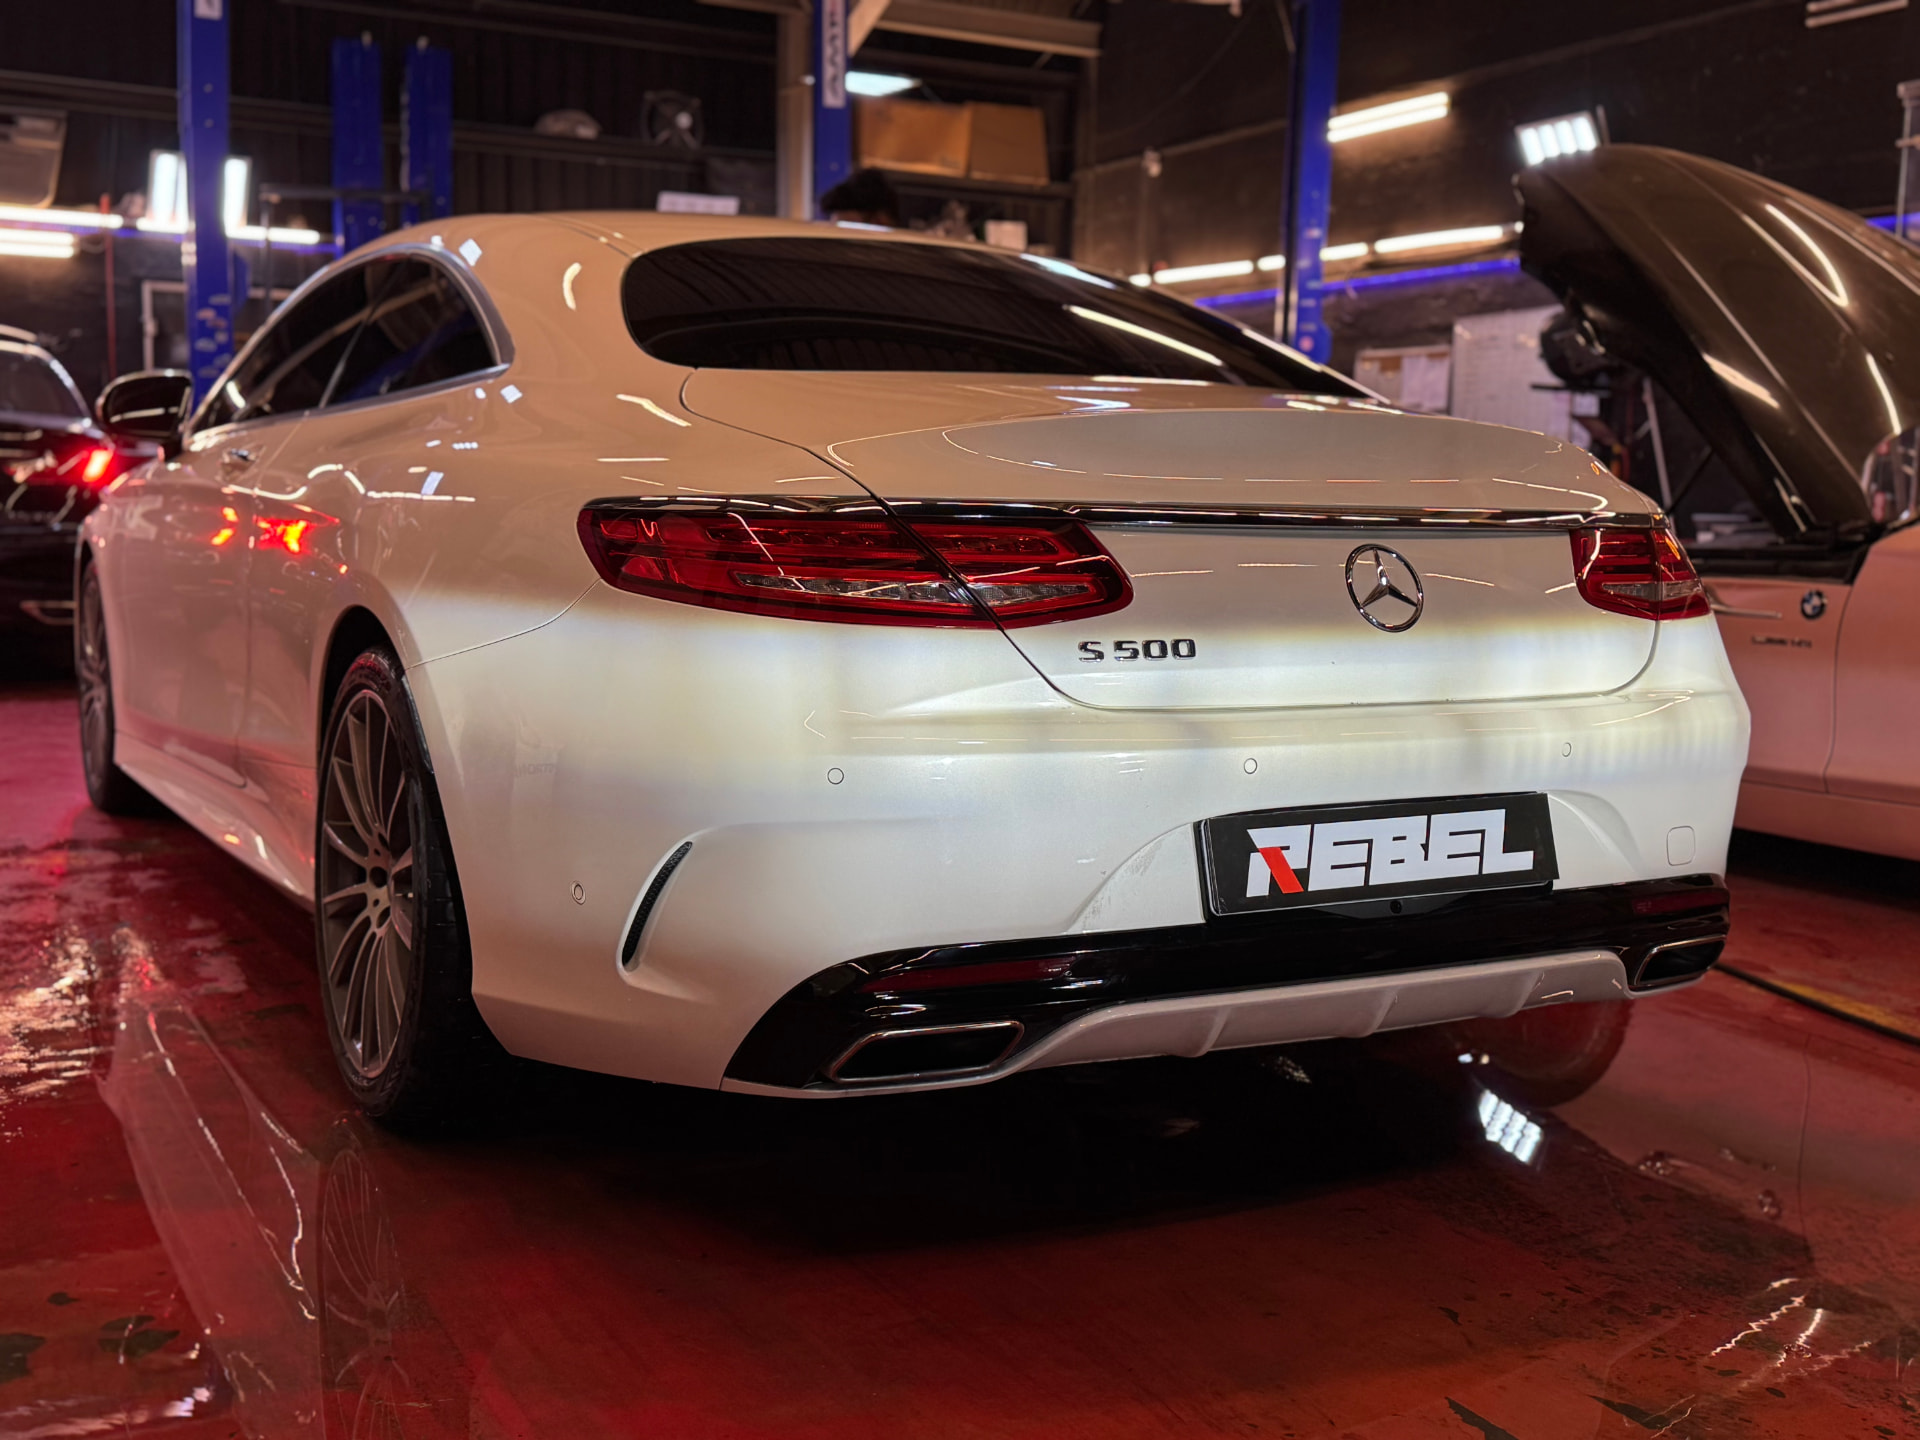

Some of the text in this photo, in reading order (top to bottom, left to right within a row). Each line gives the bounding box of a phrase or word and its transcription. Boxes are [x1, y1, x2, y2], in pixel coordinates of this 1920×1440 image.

[1078, 638, 1196, 662] S 500
[1246, 808, 1534, 898] REBEL
